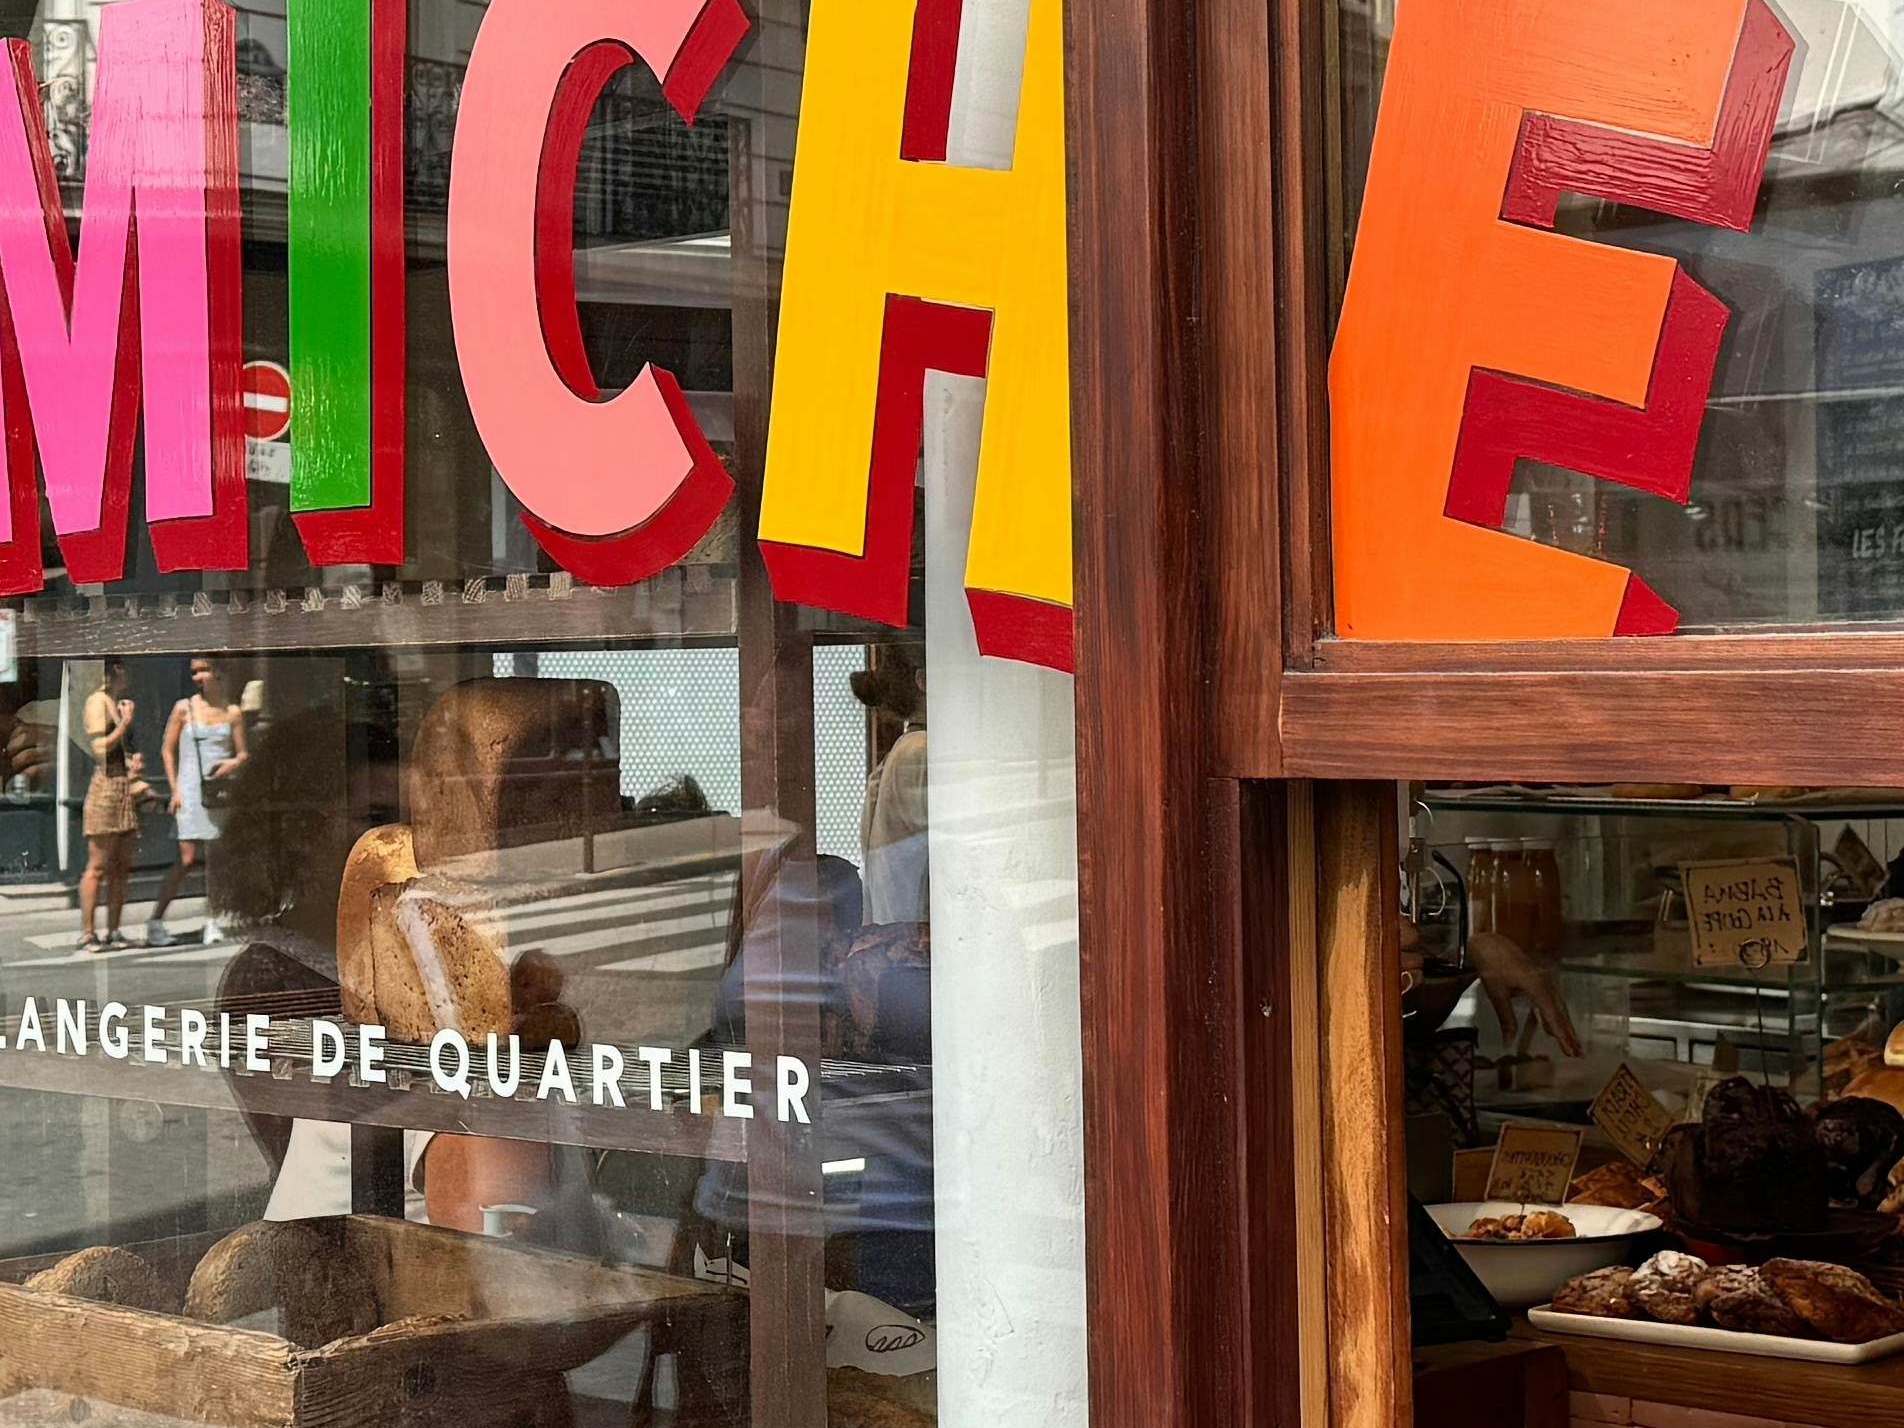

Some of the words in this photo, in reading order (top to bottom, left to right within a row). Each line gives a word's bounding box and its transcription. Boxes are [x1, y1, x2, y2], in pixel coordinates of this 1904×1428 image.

[1853, 523, 1886, 559] LES
[312, 1019, 387, 1083] DE
[429, 1028, 812, 1125] QUARTIER
